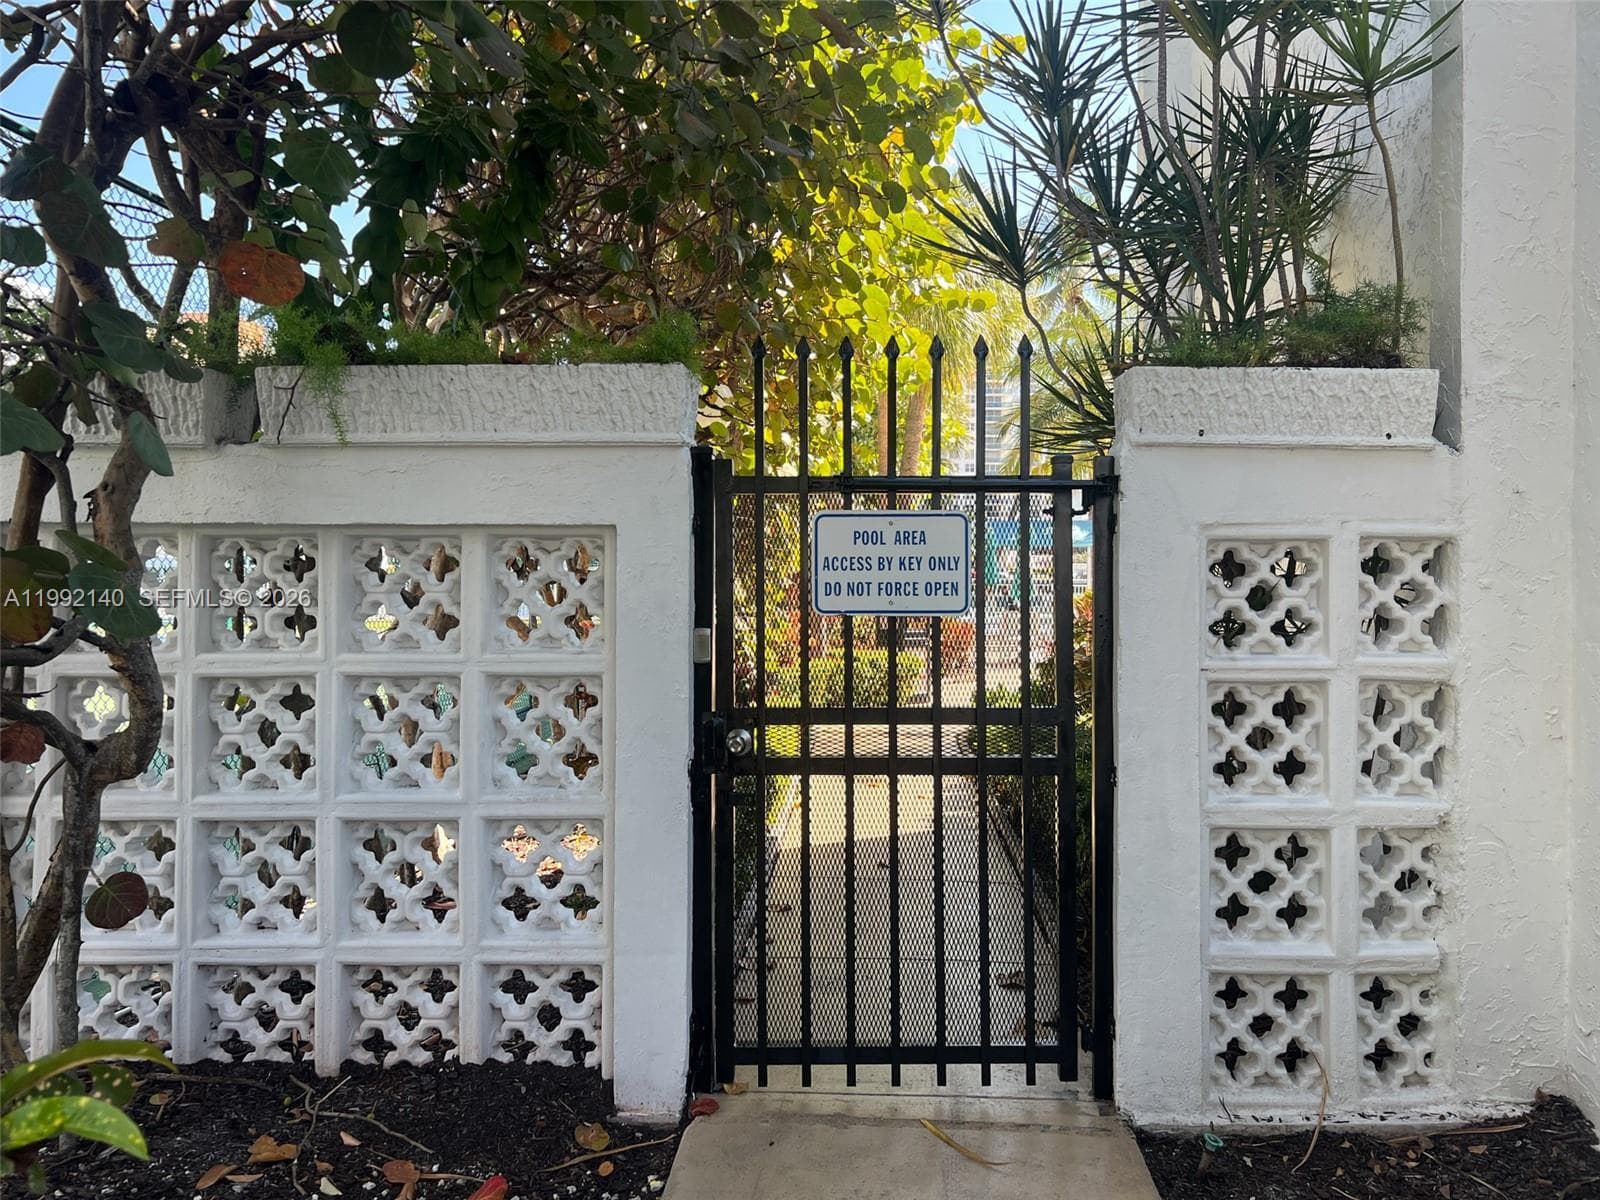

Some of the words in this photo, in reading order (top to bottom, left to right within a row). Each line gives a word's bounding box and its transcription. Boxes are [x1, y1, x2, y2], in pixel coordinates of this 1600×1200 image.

[853, 530, 886, 546] POOL
[894, 530, 927, 546] AREA
[822, 556, 873, 571] ACCESS
[877, 556, 893, 571] BY
[899, 556, 923, 571] KEY
[928, 556, 960, 571] ONLY
[824, 581, 842, 597] DO
[847, 581, 872, 597] NOT
[877, 581, 920, 597] FORCE
[924, 581, 959, 597] OPEN
